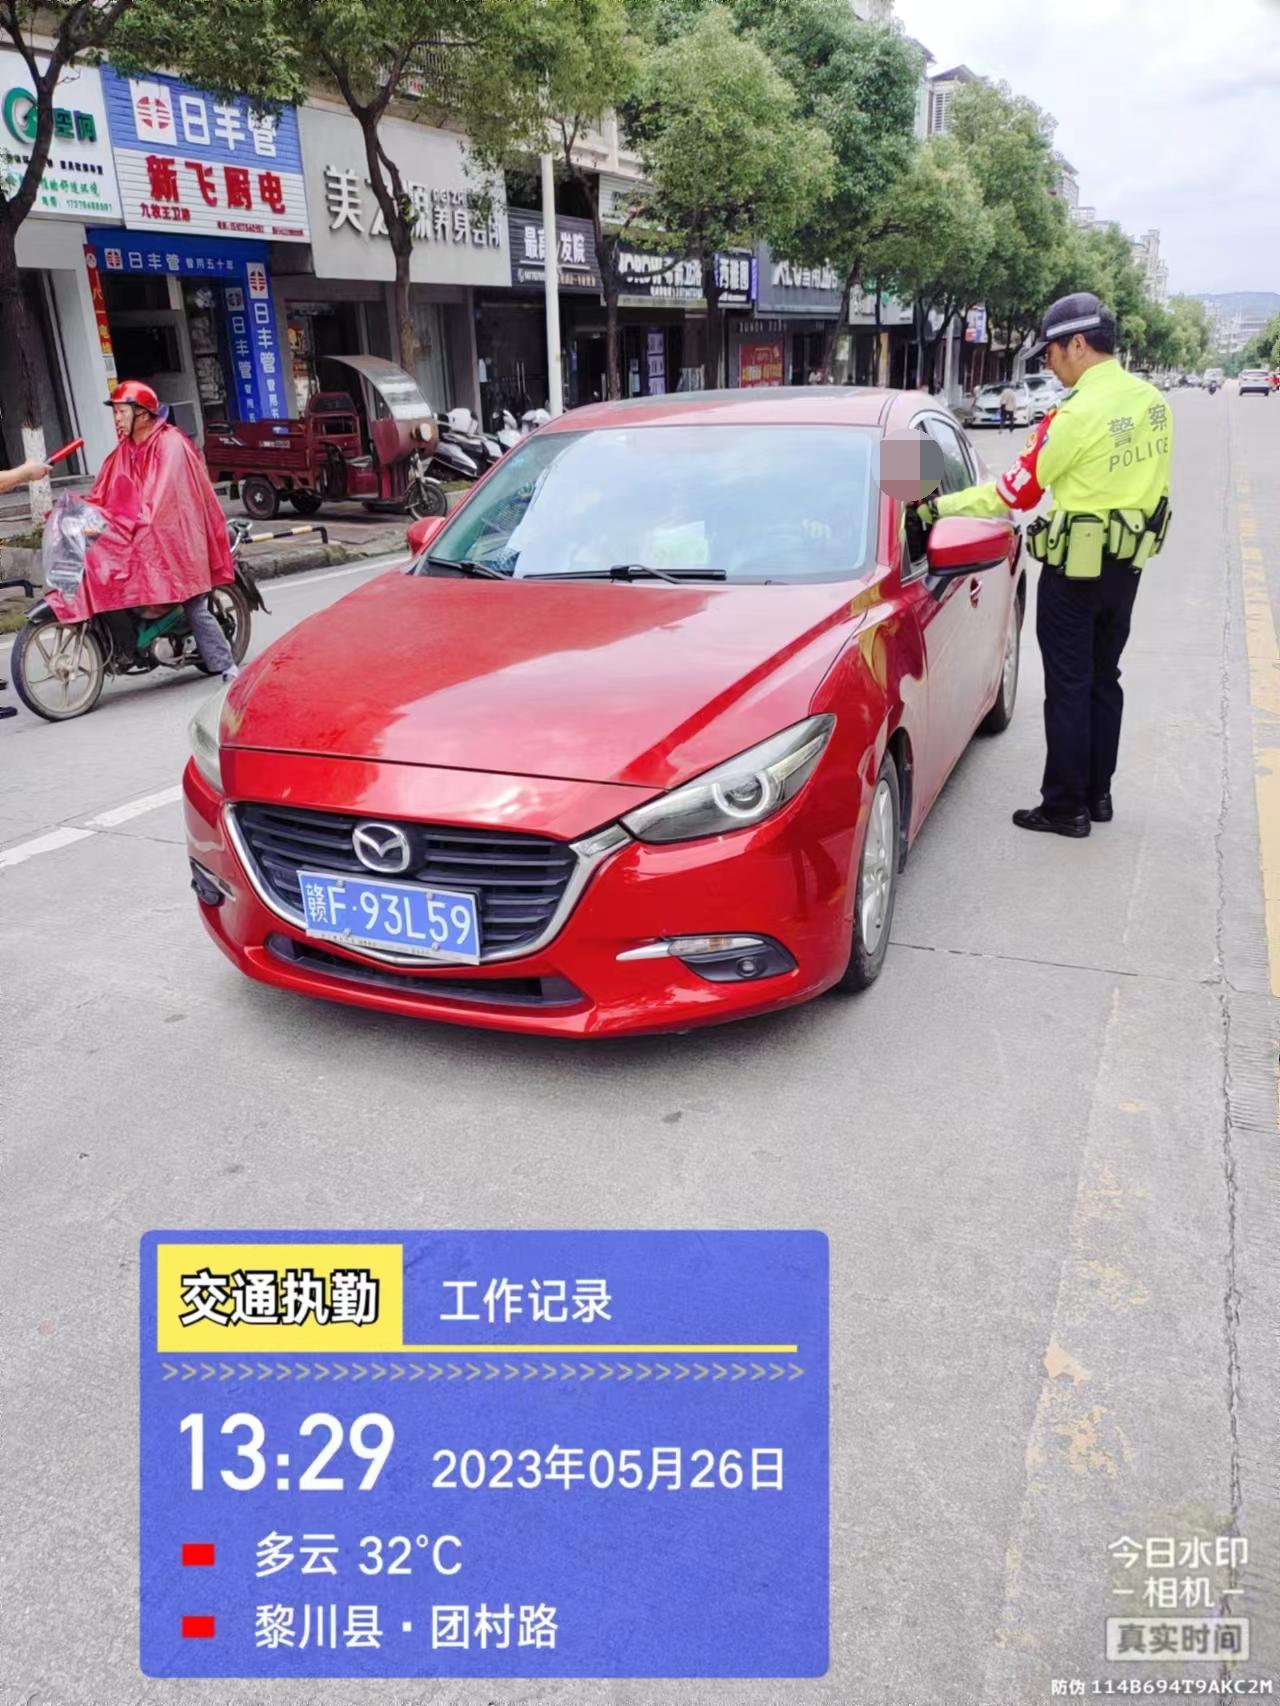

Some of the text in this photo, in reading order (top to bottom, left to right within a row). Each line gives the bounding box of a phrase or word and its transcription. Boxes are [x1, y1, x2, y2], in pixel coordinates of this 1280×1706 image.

[179, 95, 277, 158] 日丰管
[146, 155, 286, 215] 新飞厨电
[128, 252, 180, 271] 日丰管
[231, 316, 252, 379] 日丰管
[254, 303, 275, 374] 日丰管
[1108, 404, 1168, 448] 警察
[1109, 437, 1168, 472] POLICE
